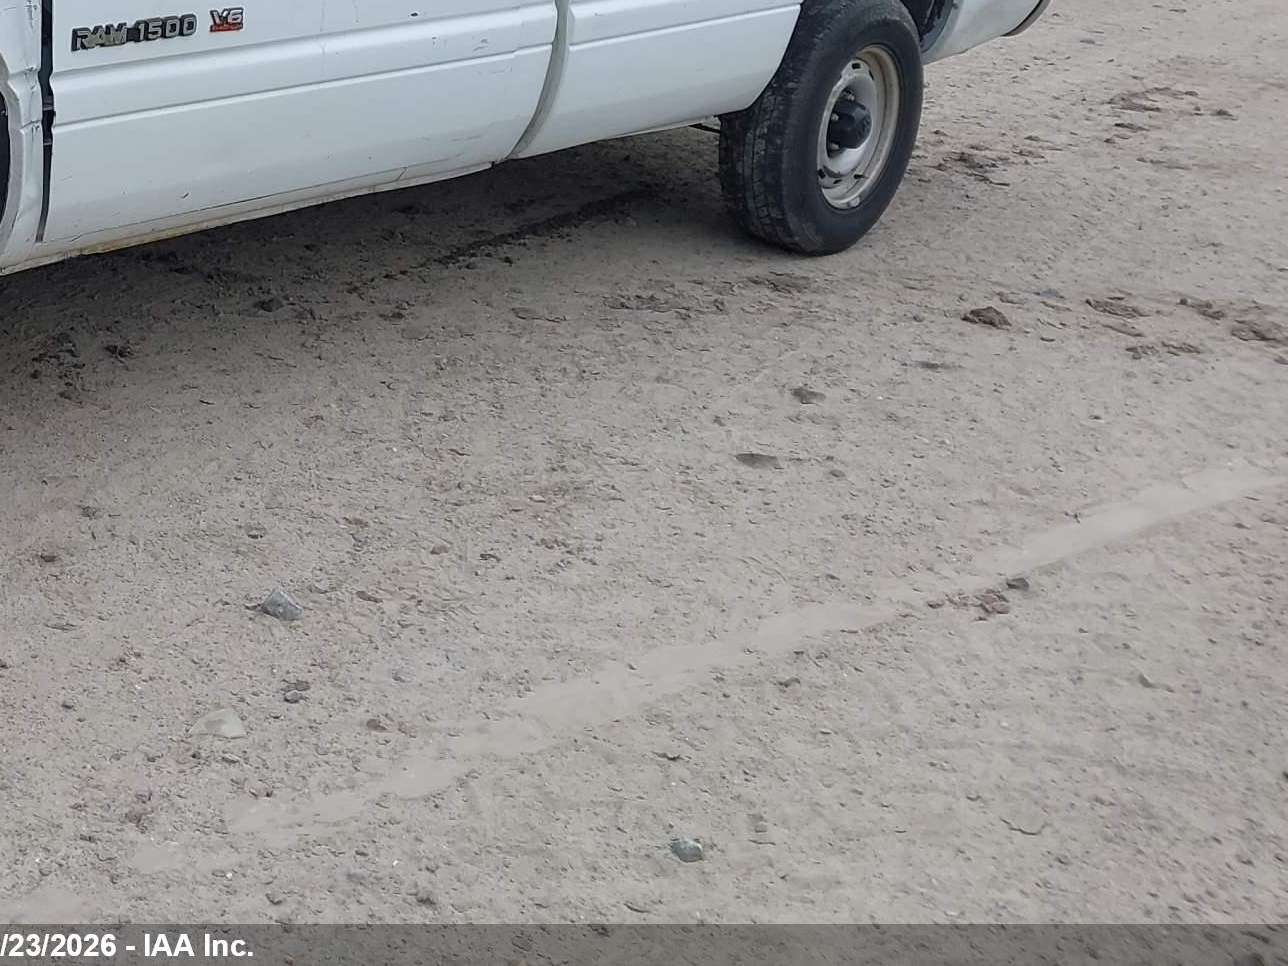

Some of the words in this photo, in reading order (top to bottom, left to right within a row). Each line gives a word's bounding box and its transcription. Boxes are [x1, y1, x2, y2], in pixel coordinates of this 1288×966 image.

[71, 22, 128, 52] RAM
[133, 14, 197, 43] 1500
[209, 7, 244, 26] V6
